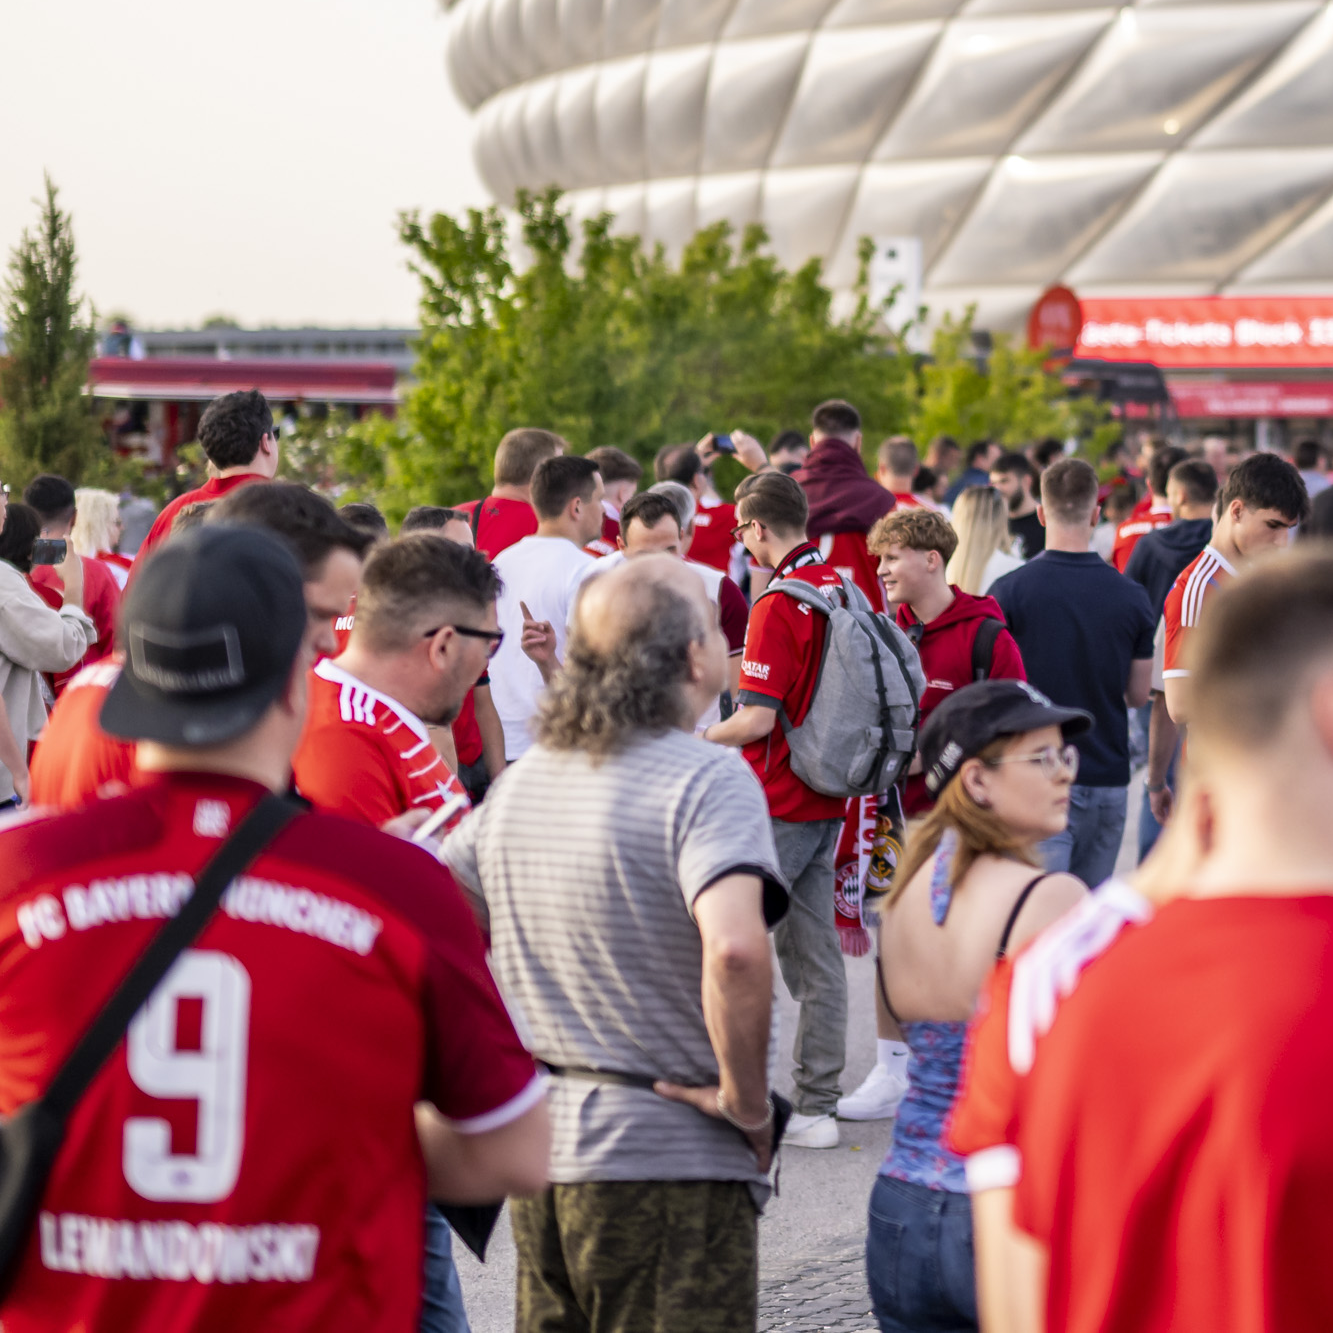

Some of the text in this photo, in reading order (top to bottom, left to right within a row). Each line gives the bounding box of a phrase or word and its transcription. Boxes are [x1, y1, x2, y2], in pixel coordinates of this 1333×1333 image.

[1234, 317, 1303, 347] Block
[335, 616, 355, 631] MO
[741, 661, 770, 675] QATAR
[17, 894, 67, 950] FC
[122, 949, 252, 1203] 9
[39, 1211, 320, 1285] LEWANDOWSKI
